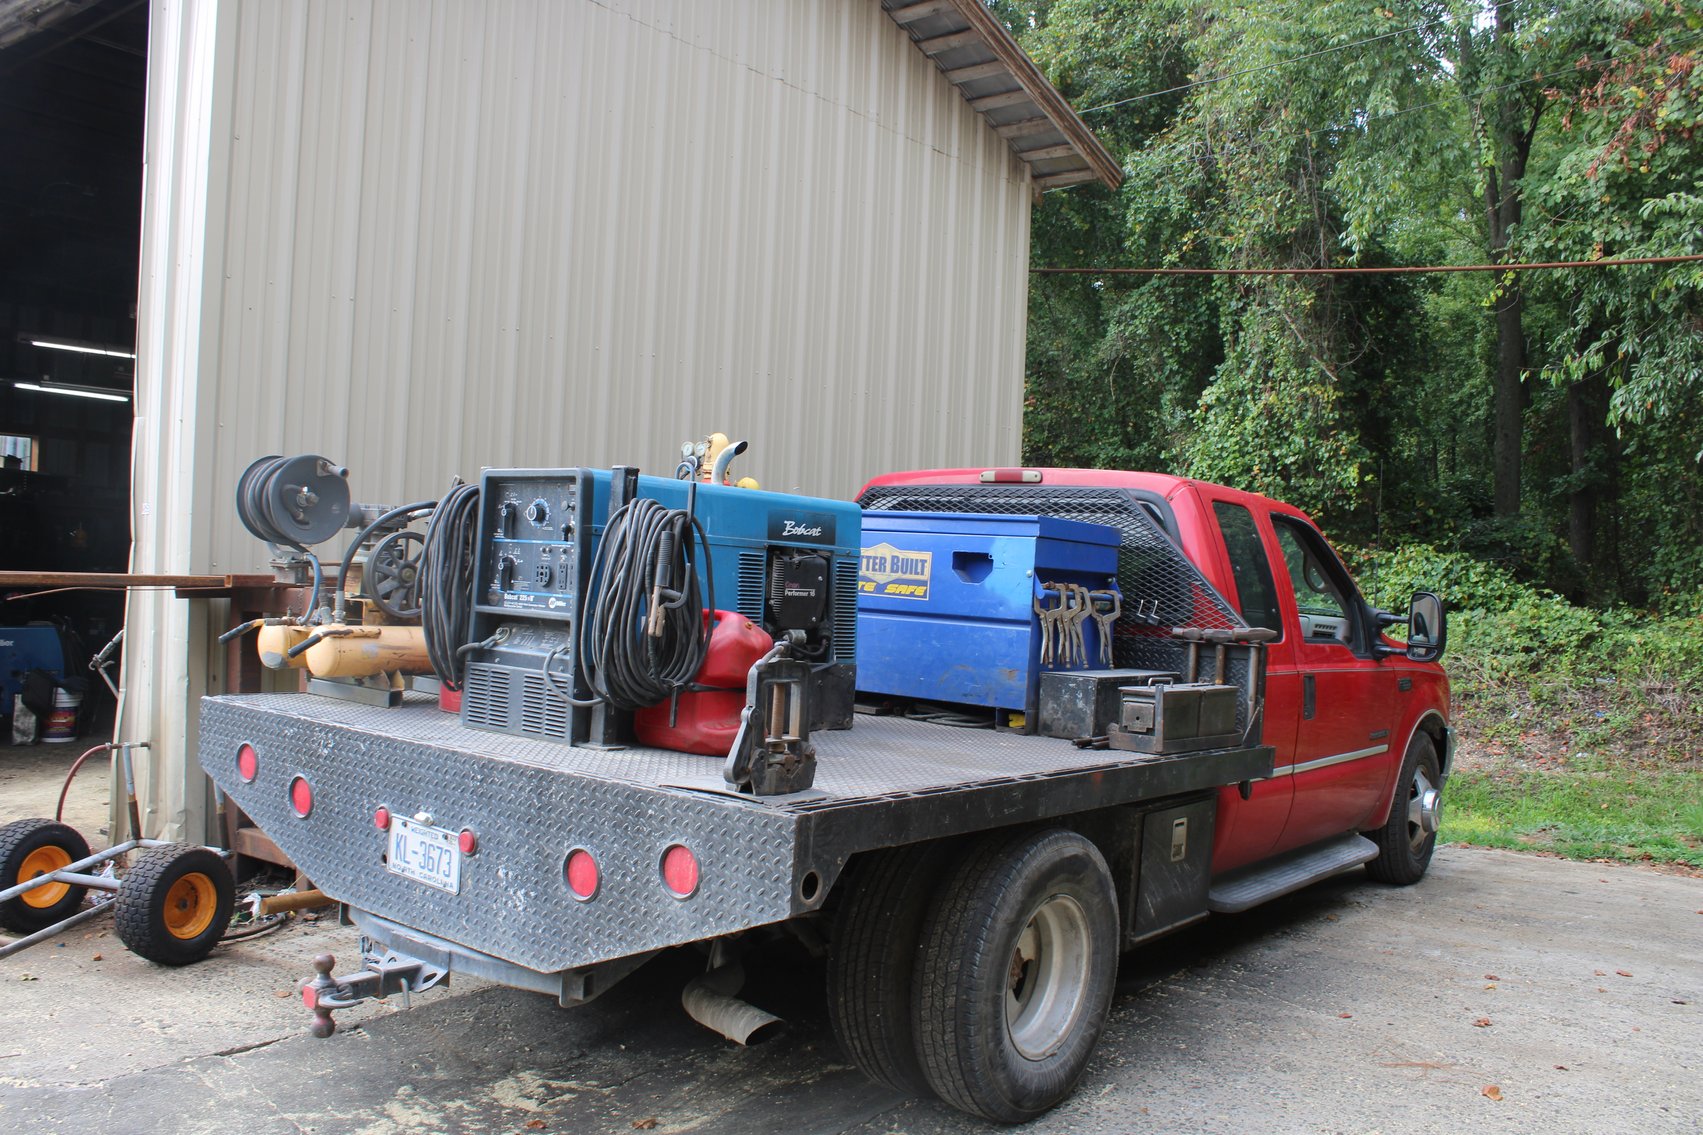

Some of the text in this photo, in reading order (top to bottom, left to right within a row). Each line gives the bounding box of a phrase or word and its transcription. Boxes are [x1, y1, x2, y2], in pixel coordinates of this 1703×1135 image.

[782, 520, 822, 537] Bobcat
[884, 583, 927, 596] SAFE
[395, 833, 452, 878] KL-3673
[392, 862, 454, 889] NORTH CAROLINA
